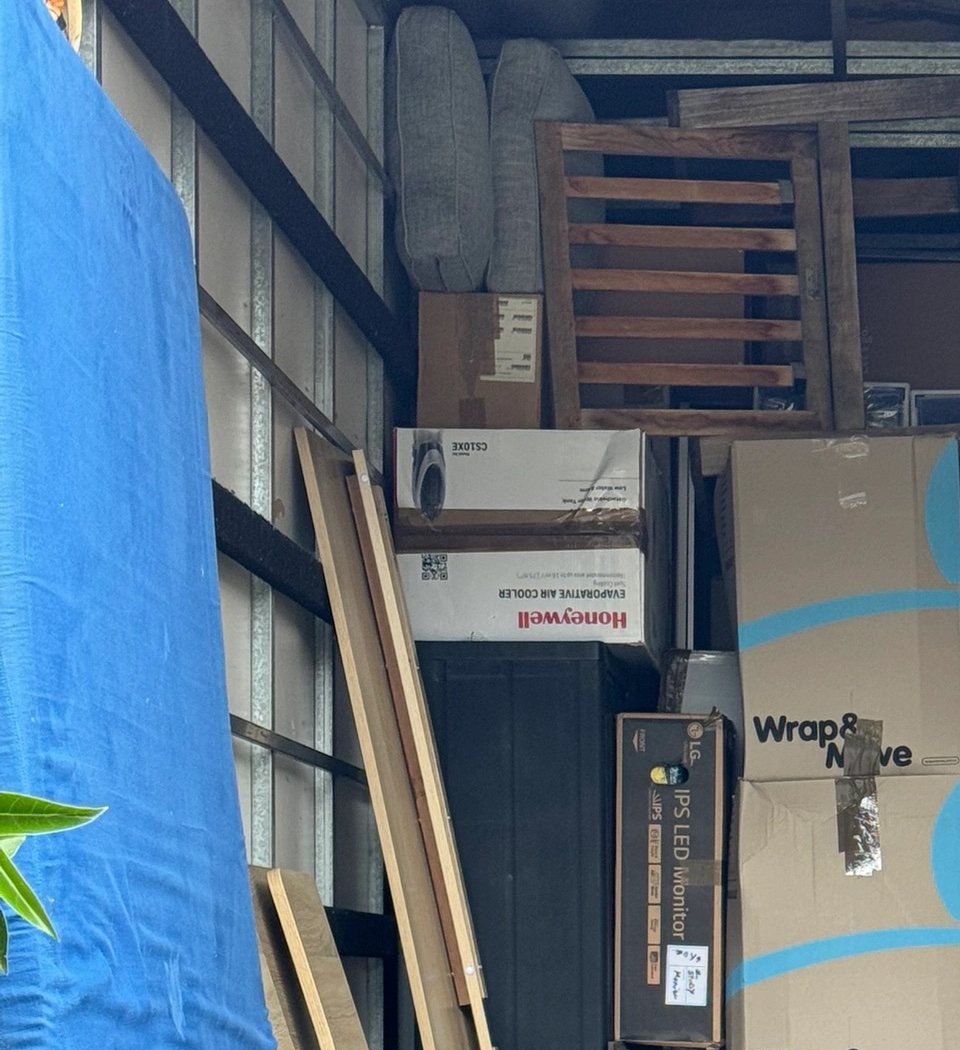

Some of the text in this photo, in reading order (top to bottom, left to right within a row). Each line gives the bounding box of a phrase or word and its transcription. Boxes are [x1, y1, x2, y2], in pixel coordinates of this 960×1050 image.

[452, 442, 488, 452] CS10XE
[498, 588, 626, 599] EVAPORATIVE AIR COOLER
[518, 607, 627, 629] Honeywell
[638, 728, 646, 753] FRONT
[753, 712, 858, 748] Wrap&
[690, 741, 702, 760] LG
[826, 742, 912, 769] Mve
[652, 802, 662, 821] IPS
[672, 789, 691, 940] IPS LED Monitor
